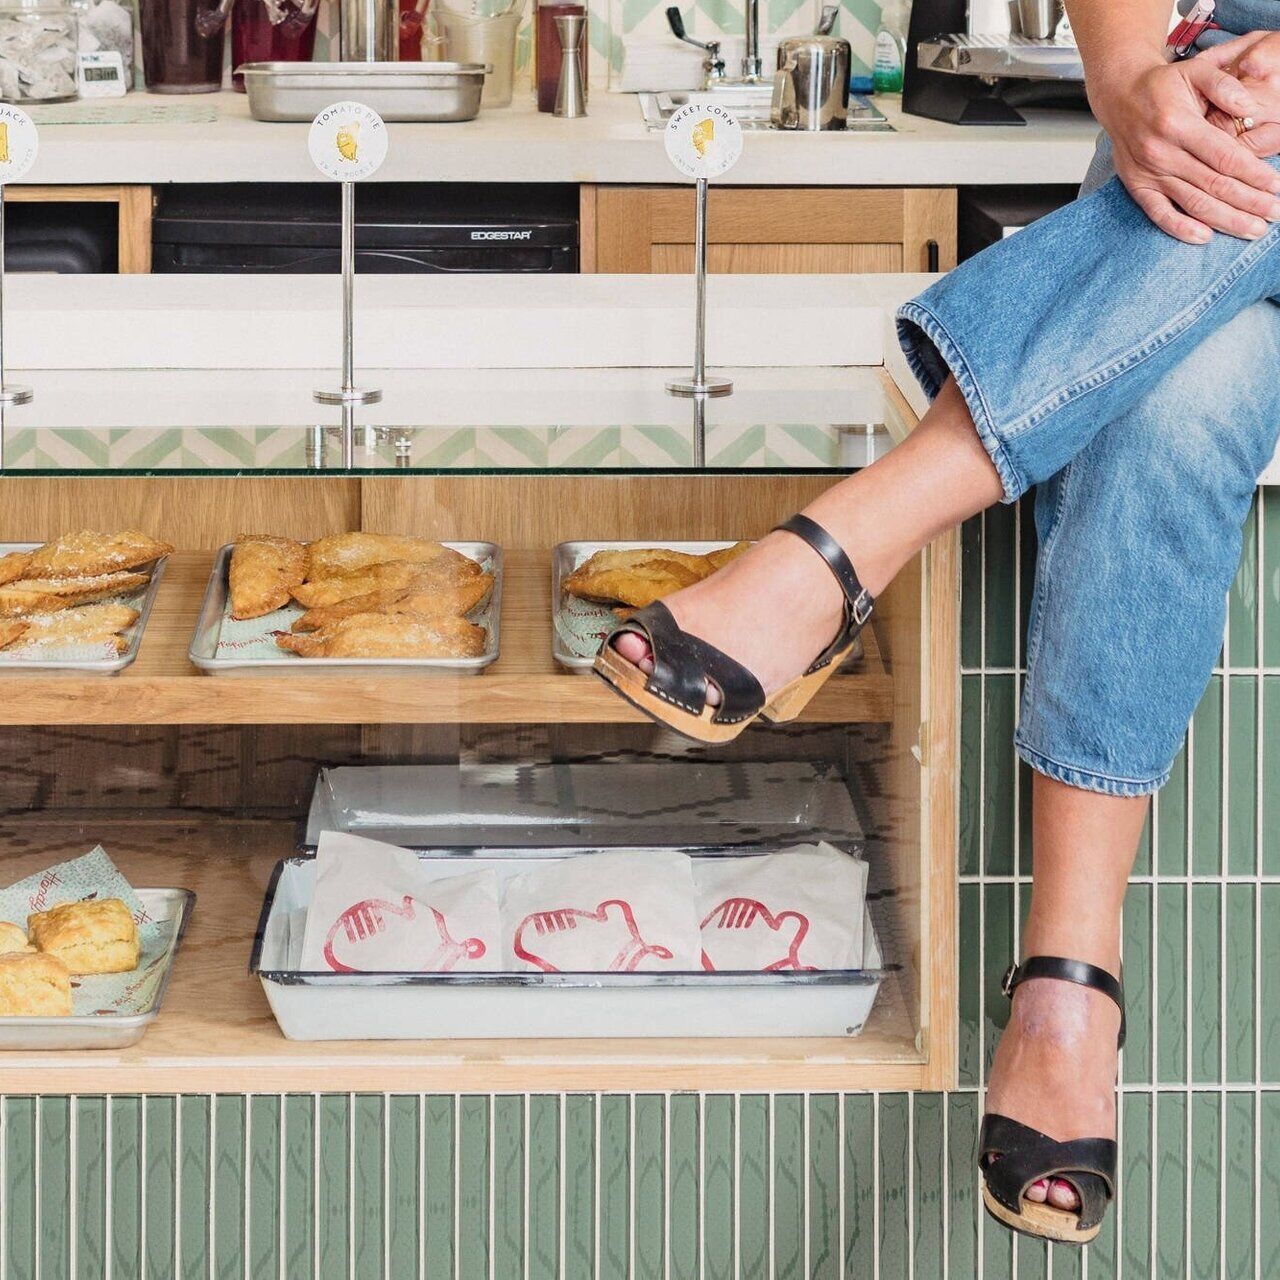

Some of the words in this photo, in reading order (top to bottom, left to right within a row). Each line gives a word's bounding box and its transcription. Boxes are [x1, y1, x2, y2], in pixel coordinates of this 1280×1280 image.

[0, 108, 26, 126] JACK
[316, 105, 362, 127] TOMATO
[365, 112, 381, 130] PIE
[670, 104, 701, 131] SWEET
[706, 104, 734, 127] CORN
[470, 230, 532, 240] EDGESTAR
[28, 870, 60, 913] Handy
